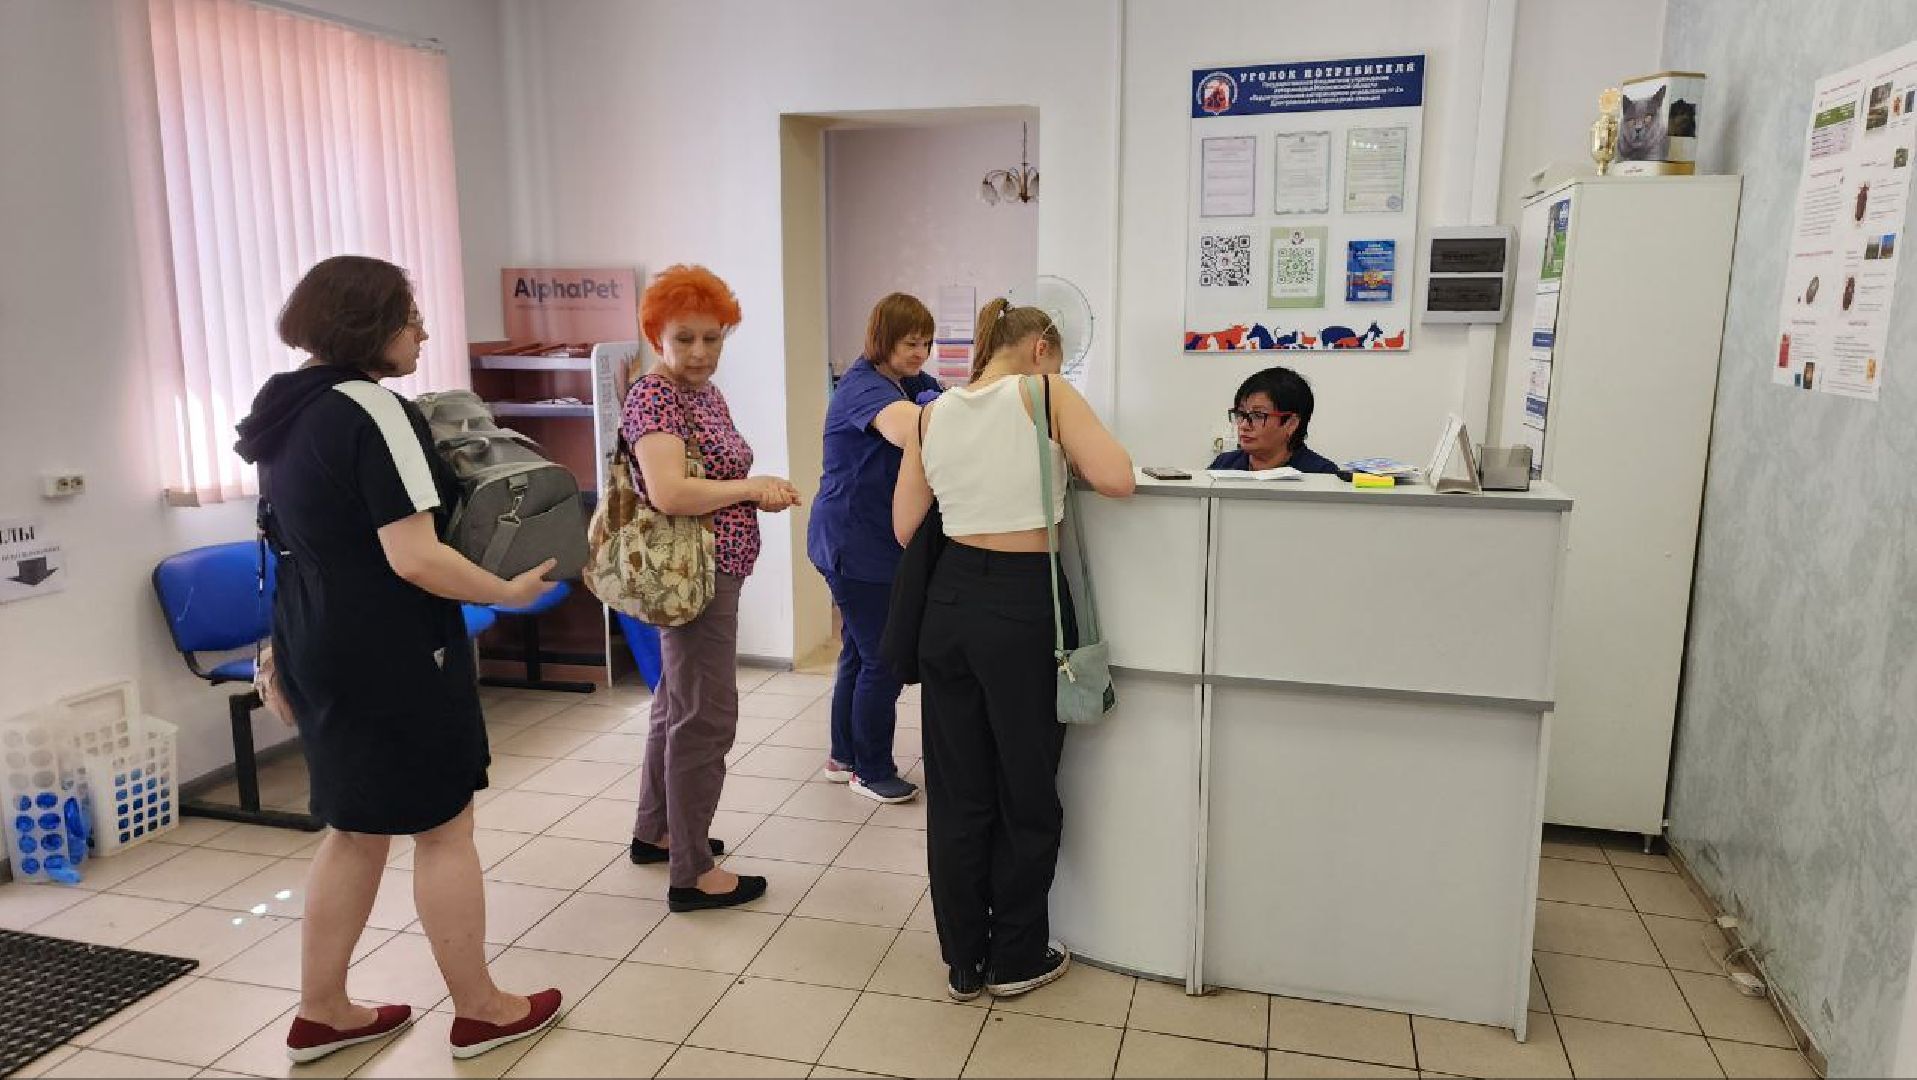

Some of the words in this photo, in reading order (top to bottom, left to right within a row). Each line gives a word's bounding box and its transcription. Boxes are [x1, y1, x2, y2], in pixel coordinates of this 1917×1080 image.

[1241, 69, 1297, 83] УГОЛОК
[1304, 62, 1416, 79] ПОТРЕБИТЕЛЯ
[514, 277, 620, 302] AlphaPet
